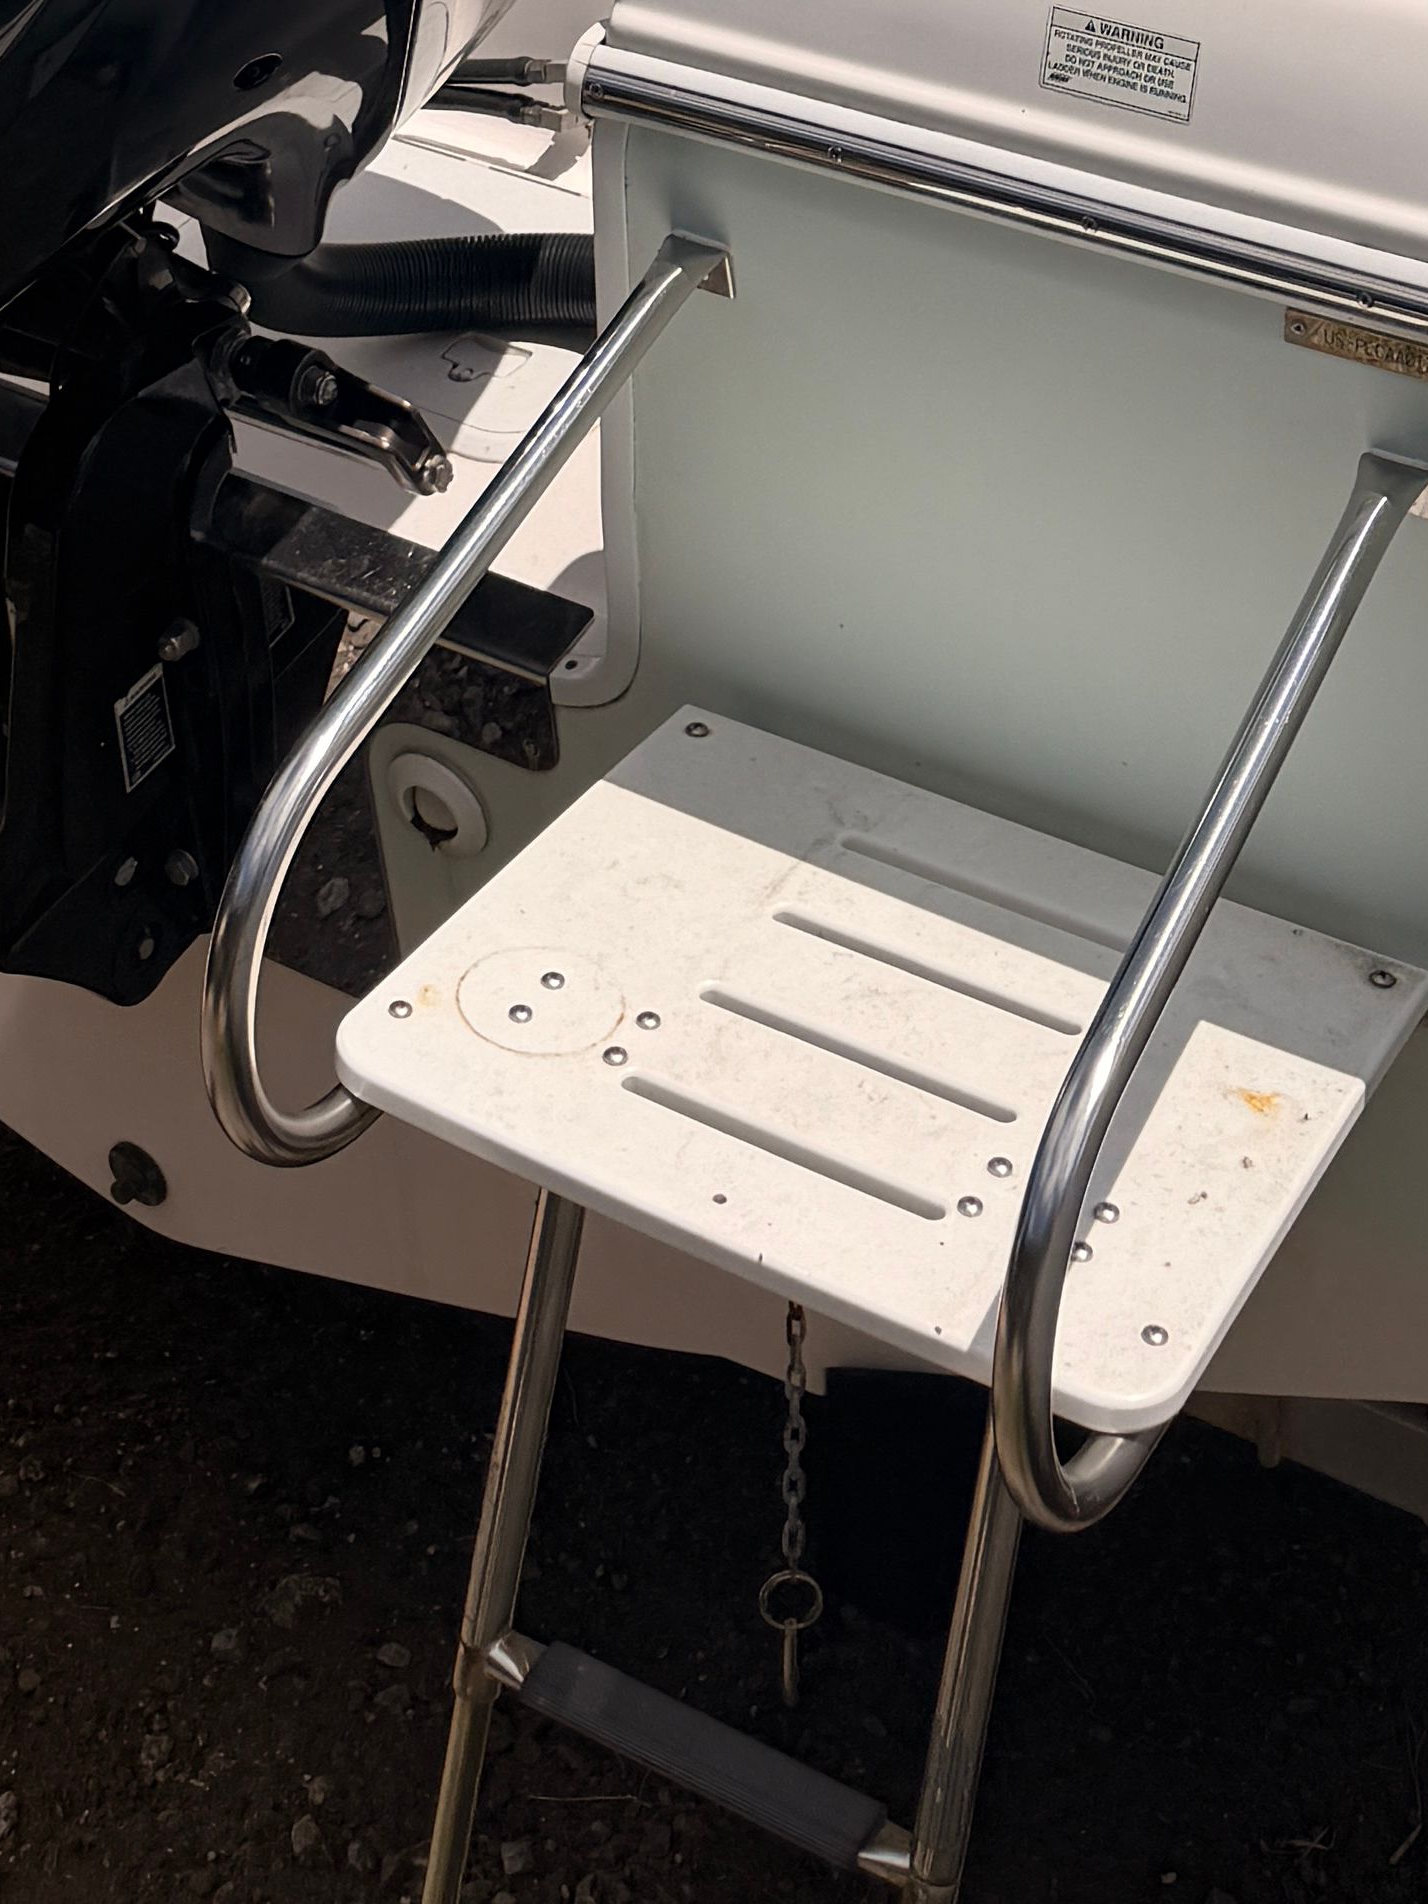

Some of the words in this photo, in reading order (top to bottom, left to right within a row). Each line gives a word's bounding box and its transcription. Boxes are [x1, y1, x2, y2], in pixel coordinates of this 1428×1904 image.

[1054, 29, 1094, 47] ROTATING
[1095, 39, 1143, 60] PROPELLER
[1144, 52, 1162, 64] MAY
[1163, 57, 1192, 71] CAUSE
[1100, 22, 1165, 50] WARNING
[1064, 54, 1077, 64] DO
[1078, 57, 1095, 68] NOT
[1096, 62, 1143, 81] APPROACH
[1143, 73, 1156, 84] OR
[1157, 77, 1174, 89] USE
[1066, 43, 1102, 60] SERIOUS
[1102, 53, 1132, 67] INJURY
[1133, 60, 1145, 72] OR
[1082, 68, 1107, 83] WHEN
[1107, 75, 1139, 91] ENGINE
[1139, 84, 1148, 94] IS
